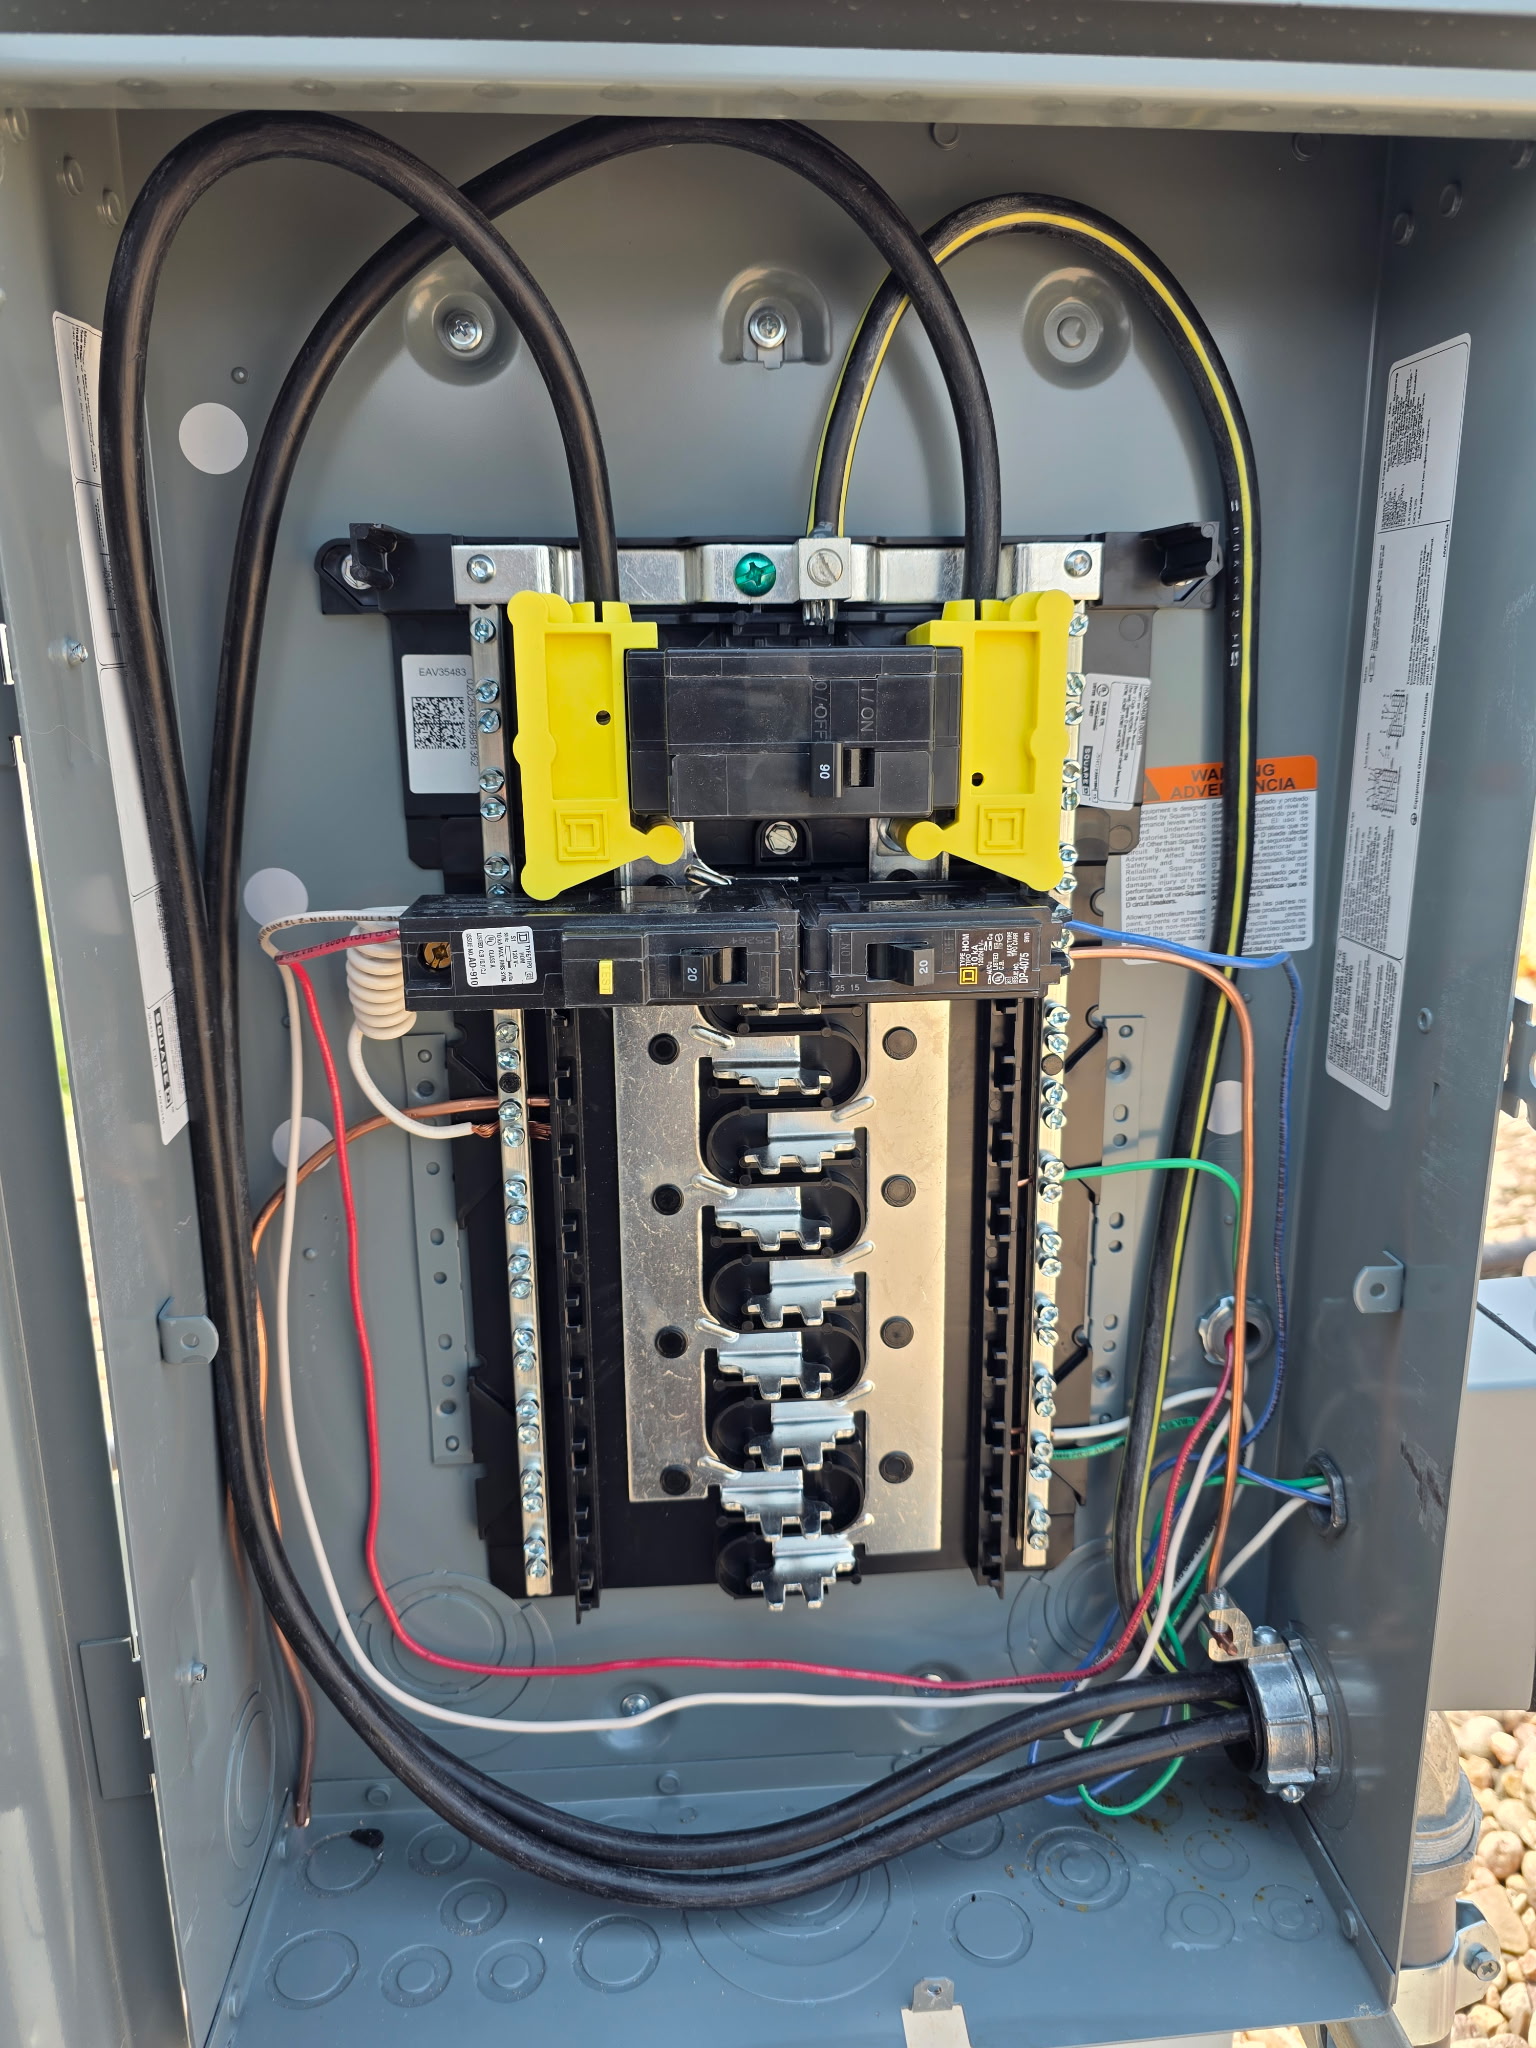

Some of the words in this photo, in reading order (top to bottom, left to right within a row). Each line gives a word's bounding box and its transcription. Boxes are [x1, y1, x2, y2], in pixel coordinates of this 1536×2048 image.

[419, 667, 467, 677] EAV35483
[814, 705, 828, 740] OFF
[861, 706, 875, 732] ON
[819, 763, 831, 780] 90
[1082, 747, 1092, 786] SQUARE
[1179, 804, 1206, 812] designed
[1169, 812, 1190, 820] Square
[1164, 824, 1205, 832] Underwriters
[1179, 837, 1199, 845] Square
[1267, 836, 1296, 844] seguridad
[1155, 845, 1184, 853] Breakers
[1126, 854, 1158, 862] Adversely
[1126, 861, 1147, 869] Safety
[1126, 867, 1160, 875] Reliability.
[1169, 864, 1192, 872] Square
[1170, 871, 1193, 879] liability
[1126, 880, 1153, 888] damage,
[1126, 886, 1162, 895] performance
[1172, 889, 1205, 898] non-Square
[1126, 913, 1151, 921] Allowing
[1154, 910, 1184, 918] petroleum
[1166, 921, 1205, 929] non-metallic
[1255, 925, 1279, 933] petróleo
[1282, 923, 1305, 931] podrían
[962, 934, 970, 951] HOM
[971, 944, 978, 954] kA
[971, 957, 978, 966] 10
[468, 957, 478, 986] AD-910
[919, 960, 928, 974] 20
[1019, 952, 1029, 983] DP-4075
[602, 964, 611, 993] TEST
[687, 967, 697, 981] 20
[155, 1012, 170, 1086] SQUARE
